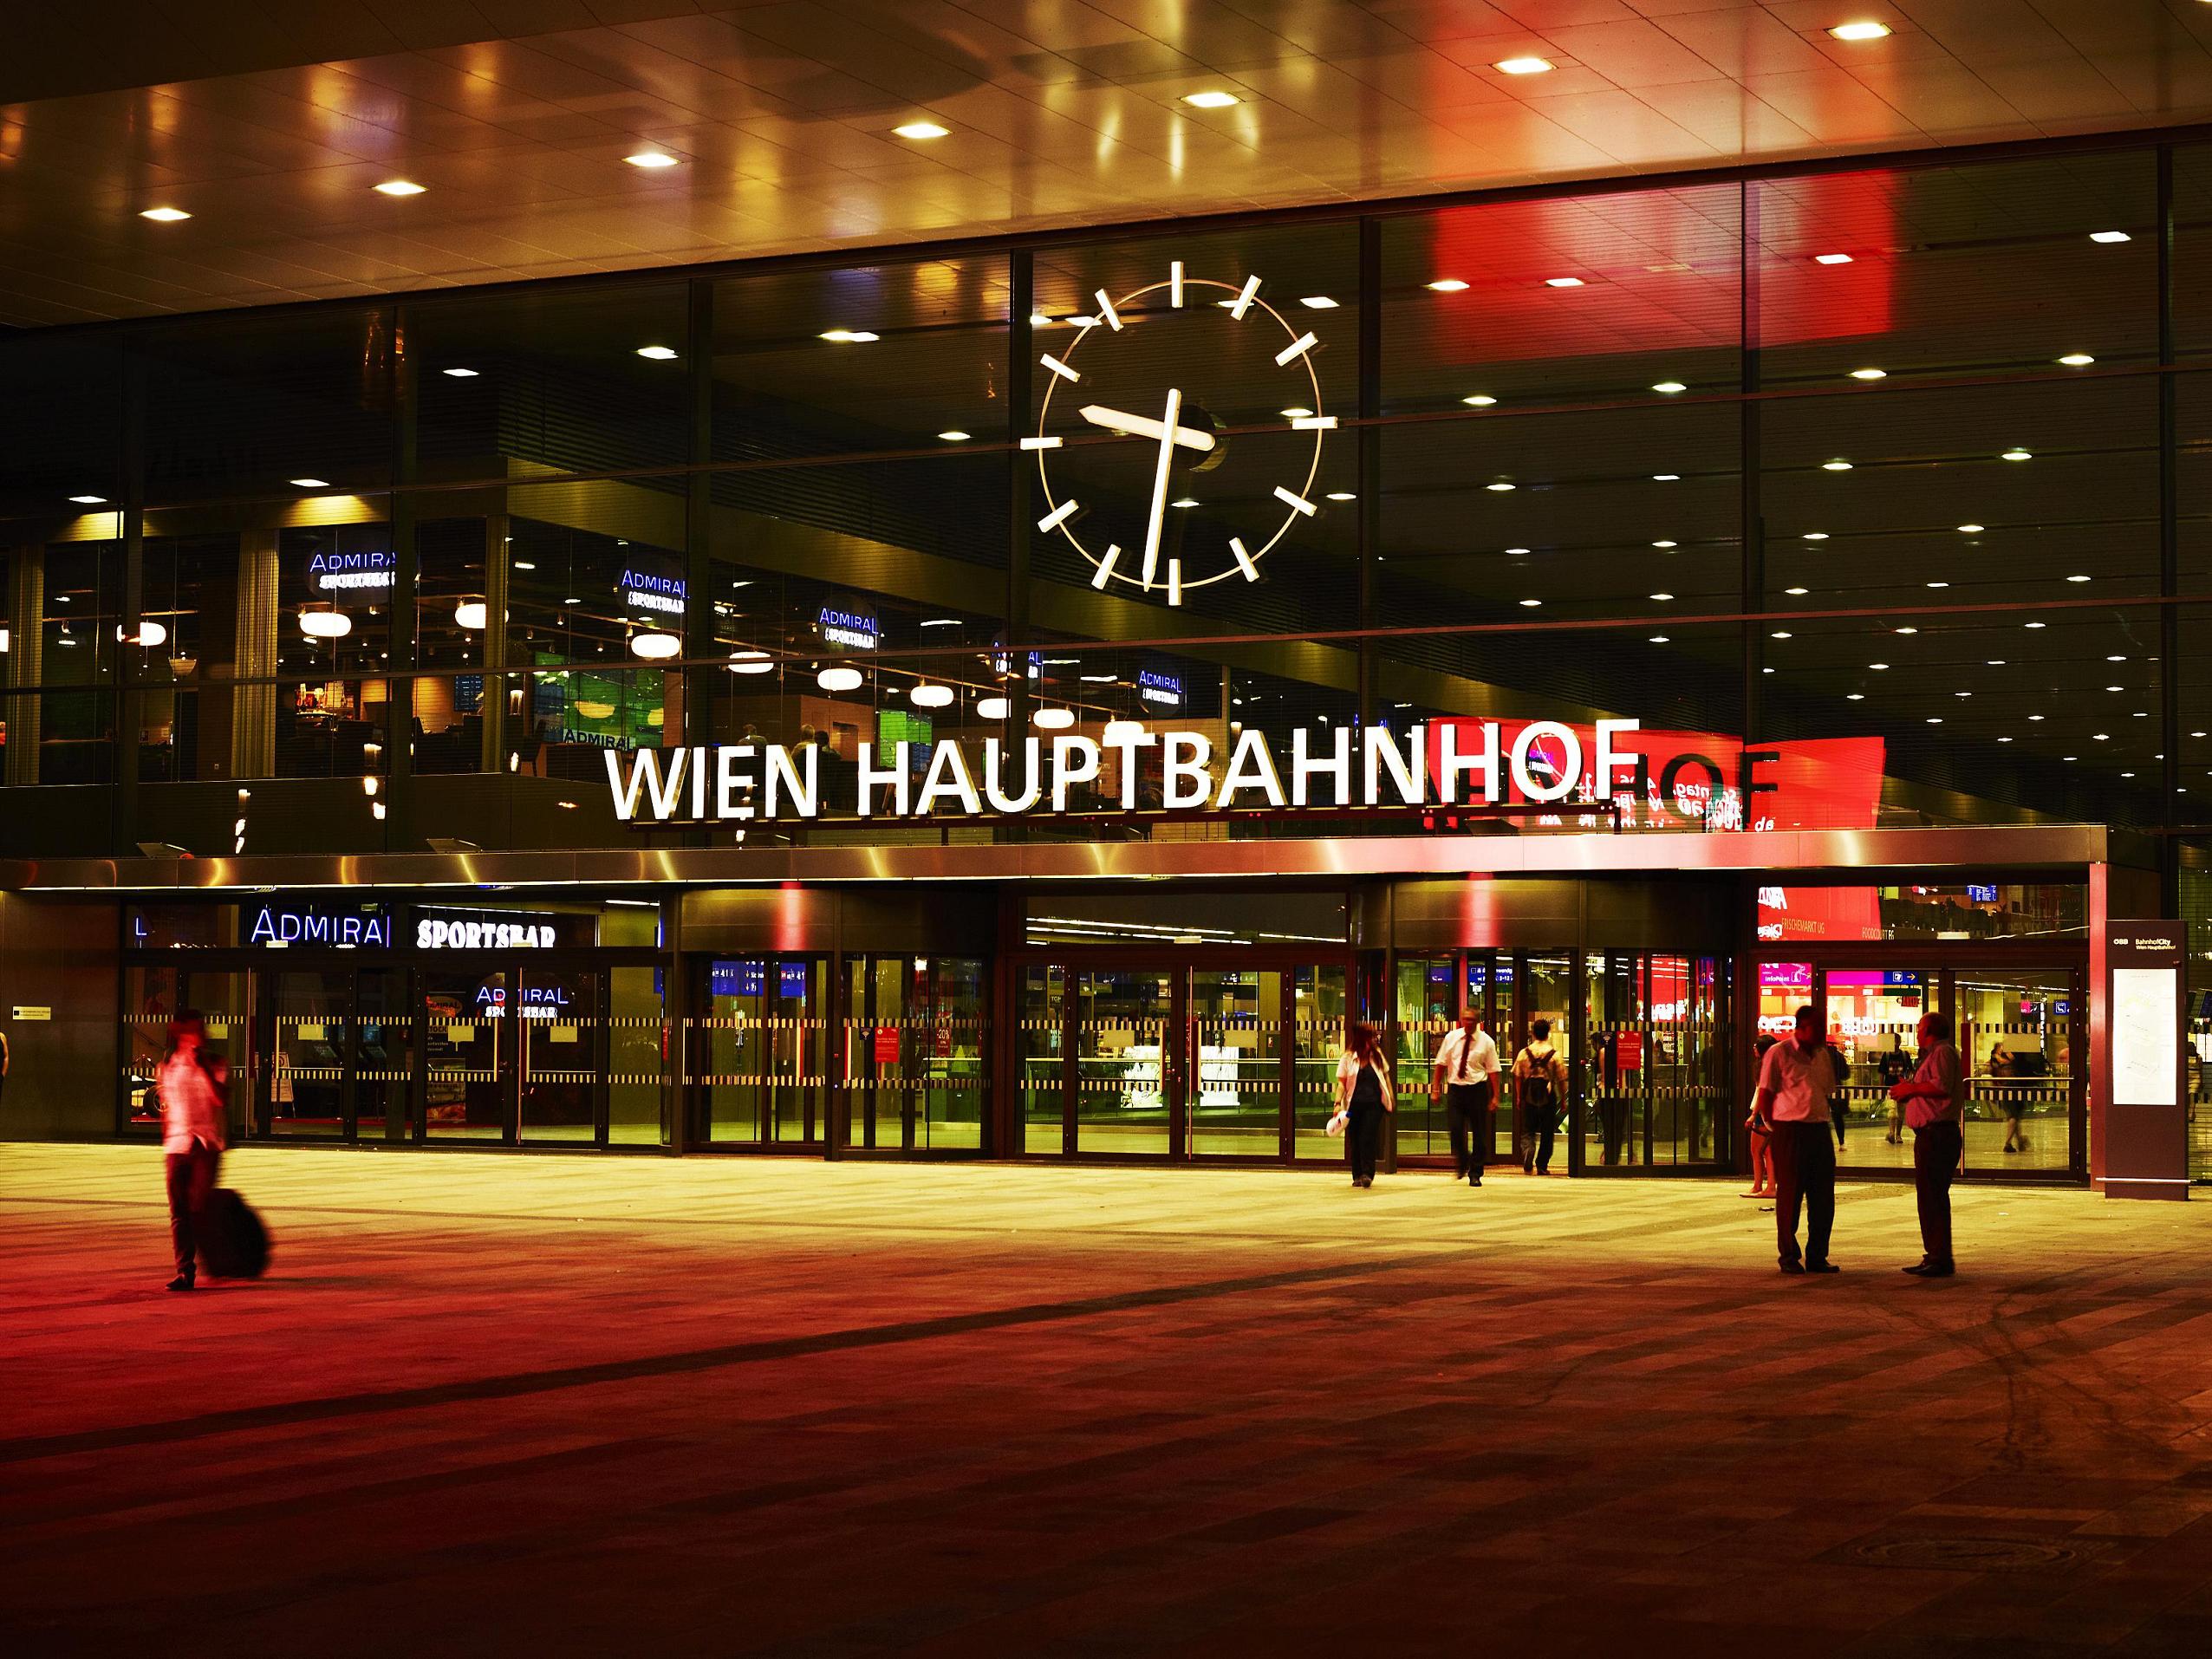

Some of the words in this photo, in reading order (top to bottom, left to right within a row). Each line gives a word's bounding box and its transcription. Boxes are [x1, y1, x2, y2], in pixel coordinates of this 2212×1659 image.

[621, 569, 690, 598] ADMIRAL
[819, 608, 879, 634] ADMIRAL
[1139, 670, 1182, 693] ADMIRAL
[604, 744, 820, 820] WIEN
[858, 719, 1642, 817] HAUPTBAHNHOF
[416, 919, 556, 948] SPORTSBAR
[1781, 918, 1818, 934] FRISCHEMARKT
[477, 986, 569, 1005] ADIRAL
